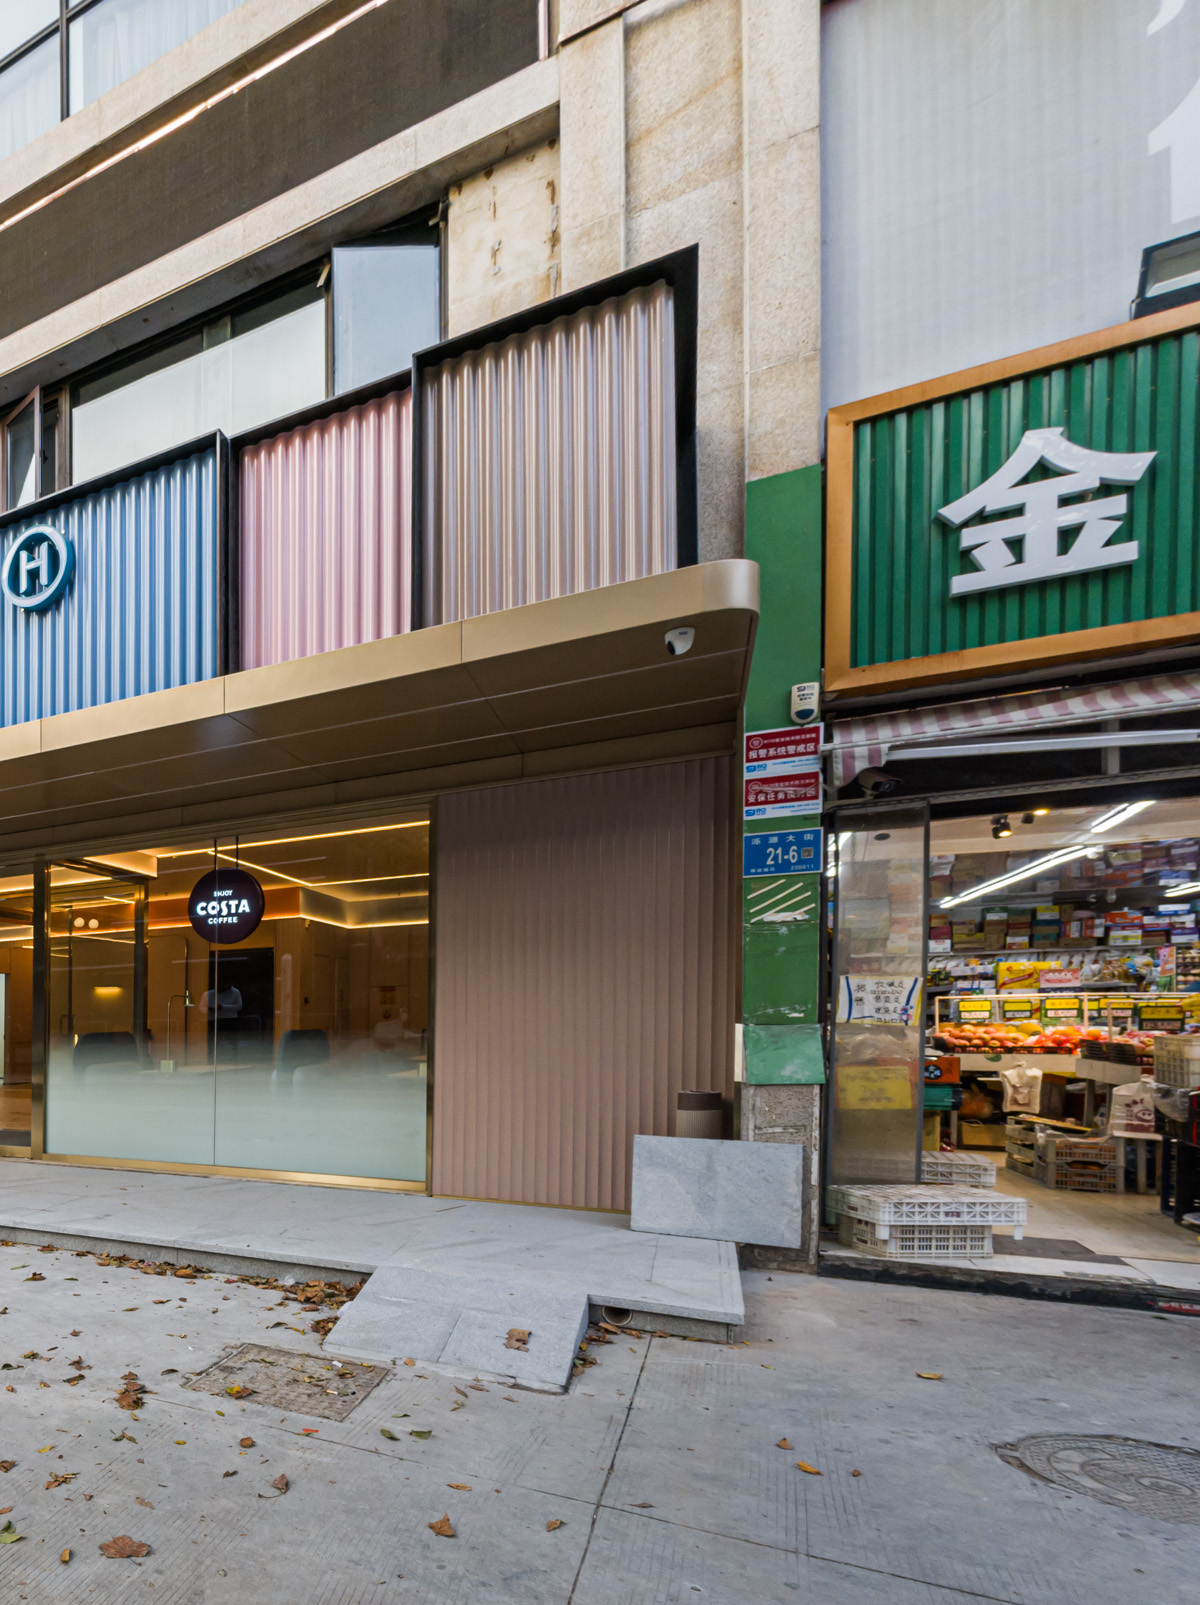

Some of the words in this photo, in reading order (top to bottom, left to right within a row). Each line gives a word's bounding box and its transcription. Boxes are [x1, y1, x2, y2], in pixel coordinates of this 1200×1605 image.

[936, 426, 1158, 598] 金
[748, 743, 816, 759] 报警系统警戒区
[766, 845, 798, 865] 21-6
[213, 889, 233, 897] ENJOY
[196, 898, 251, 916] COSTA
[208, 916, 238, 925] COFFEE
